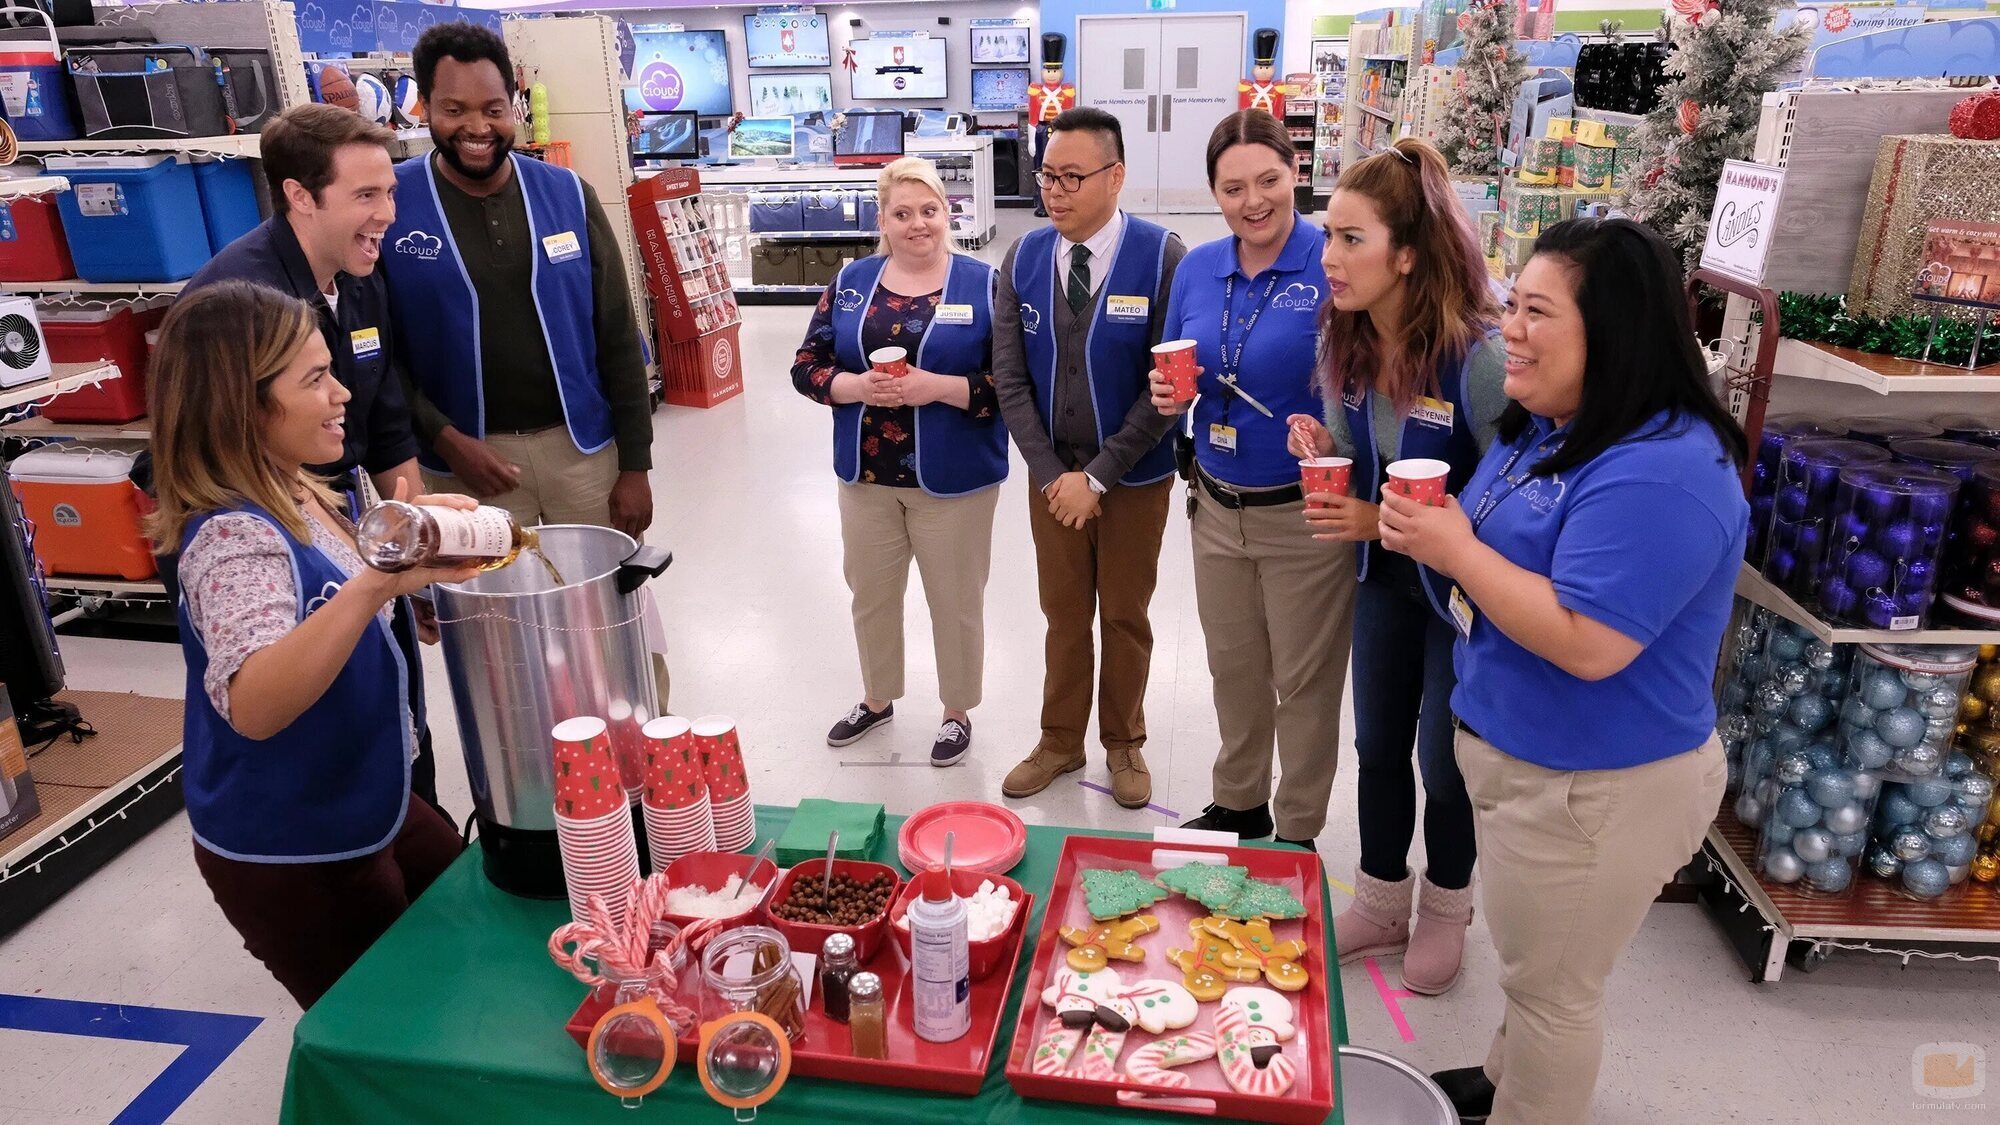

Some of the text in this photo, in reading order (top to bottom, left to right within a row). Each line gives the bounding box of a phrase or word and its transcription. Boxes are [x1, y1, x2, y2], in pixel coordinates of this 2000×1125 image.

[1851, 17, 1919, 28] Spring Water
[642, 86, 680, 97] CLOUD9
[1093, 98, 1147, 106] Team Members Only
[666, 182, 679, 191] SWEET
[1725, 170, 1778, 194] HAMMOND'S
[1717, 201, 1764, 249] CANDIES
[395, 244, 440, 256] CLOUD9
[553, 243, 574, 253] COREY
[645, 229, 683, 319] HAMMOND'S
[1263, 280, 1275, 298] CLOUD
[1114, 306, 1141, 314] MATEO
[1271, 298, 1316, 309] CLOUD9
[1245, 313, 1258, 331] CLOUD
[354, 339, 378, 351] MARCUS
[1232, 348, 1241, 367] CLOUD
[712, 382, 739, 399] HAMMOND'S
[1409, 406, 1451, 424] CHEYENNE
[1498, 455, 1516, 476] CLOUD
[1519, 485, 1556, 511] CLOUD9
[1472, 497, 1487, 519] CLOUD
